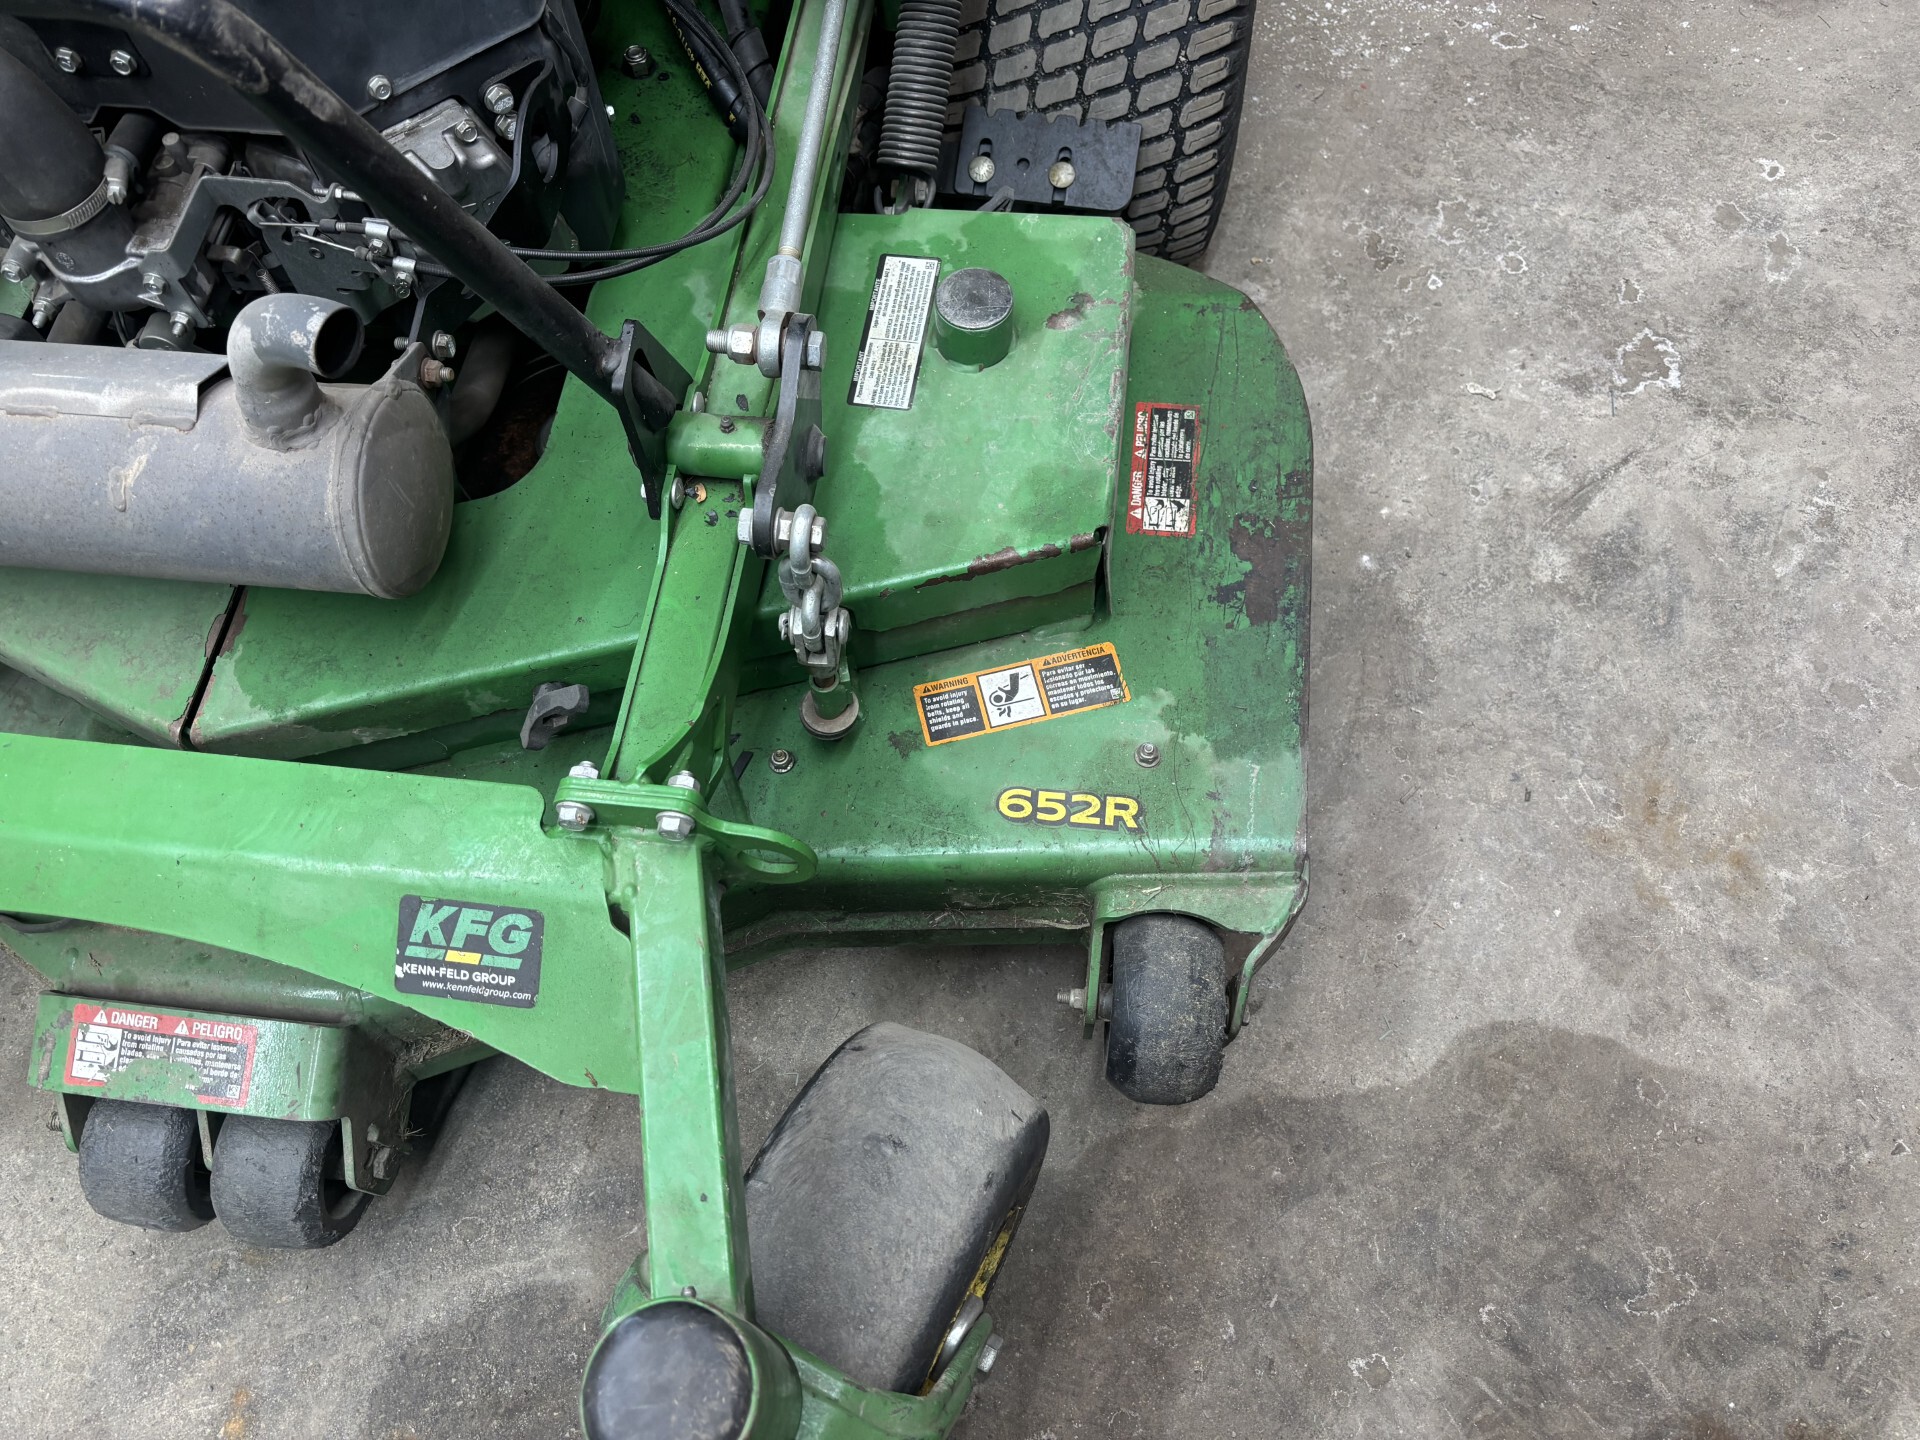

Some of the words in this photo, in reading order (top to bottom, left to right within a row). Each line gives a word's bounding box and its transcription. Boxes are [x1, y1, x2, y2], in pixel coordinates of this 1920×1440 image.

[869, 278, 881, 310] IMPORTANTE
[853, 350, 864, 381] IMPORTANT
[1131, 470, 1143, 506] DANGER
[1051, 646, 1105, 663] ADVERTENCIA
[1057, 665, 1074, 673] evitar
[931, 677, 968, 691] WARNING
[1047, 685, 1076, 696] mantener
[1076, 681, 1094, 689] todos
[932, 693, 948, 701] avoid
[949, 689, 968, 699] injury
[1049, 692, 1074, 702] escudos
[1079, 683, 1114, 695] protectores
[940, 698, 964, 708] rotating
[1068, 696, 1086, 705] lugar.
[927, 709, 944, 718] belts,
[945, 705, 960, 713] keep
[928, 715, 951, 724] shields
[930, 722, 951, 731] guards
[959, 715, 979, 725] place.
[998, 788, 1139, 828] 652R
[409, 903, 534, 954] KFG
[403, 963, 469, 980] KENN-FELD
[472, 972, 516, 986] GROUP
[422, 980, 531, 1001] www.kennfeldgroup.com
[111, 1012, 158, 1028] DANGER
[132, 1032, 151, 1041] avoid
[191, 1022, 243, 1039] PELIGRO
[175, 1048, 204, 1057] causadas
[192, 1041, 209, 1049] evitar
[210, 1043, 236, 1052] lesiones
[210, 1069, 228, 1077] borde
